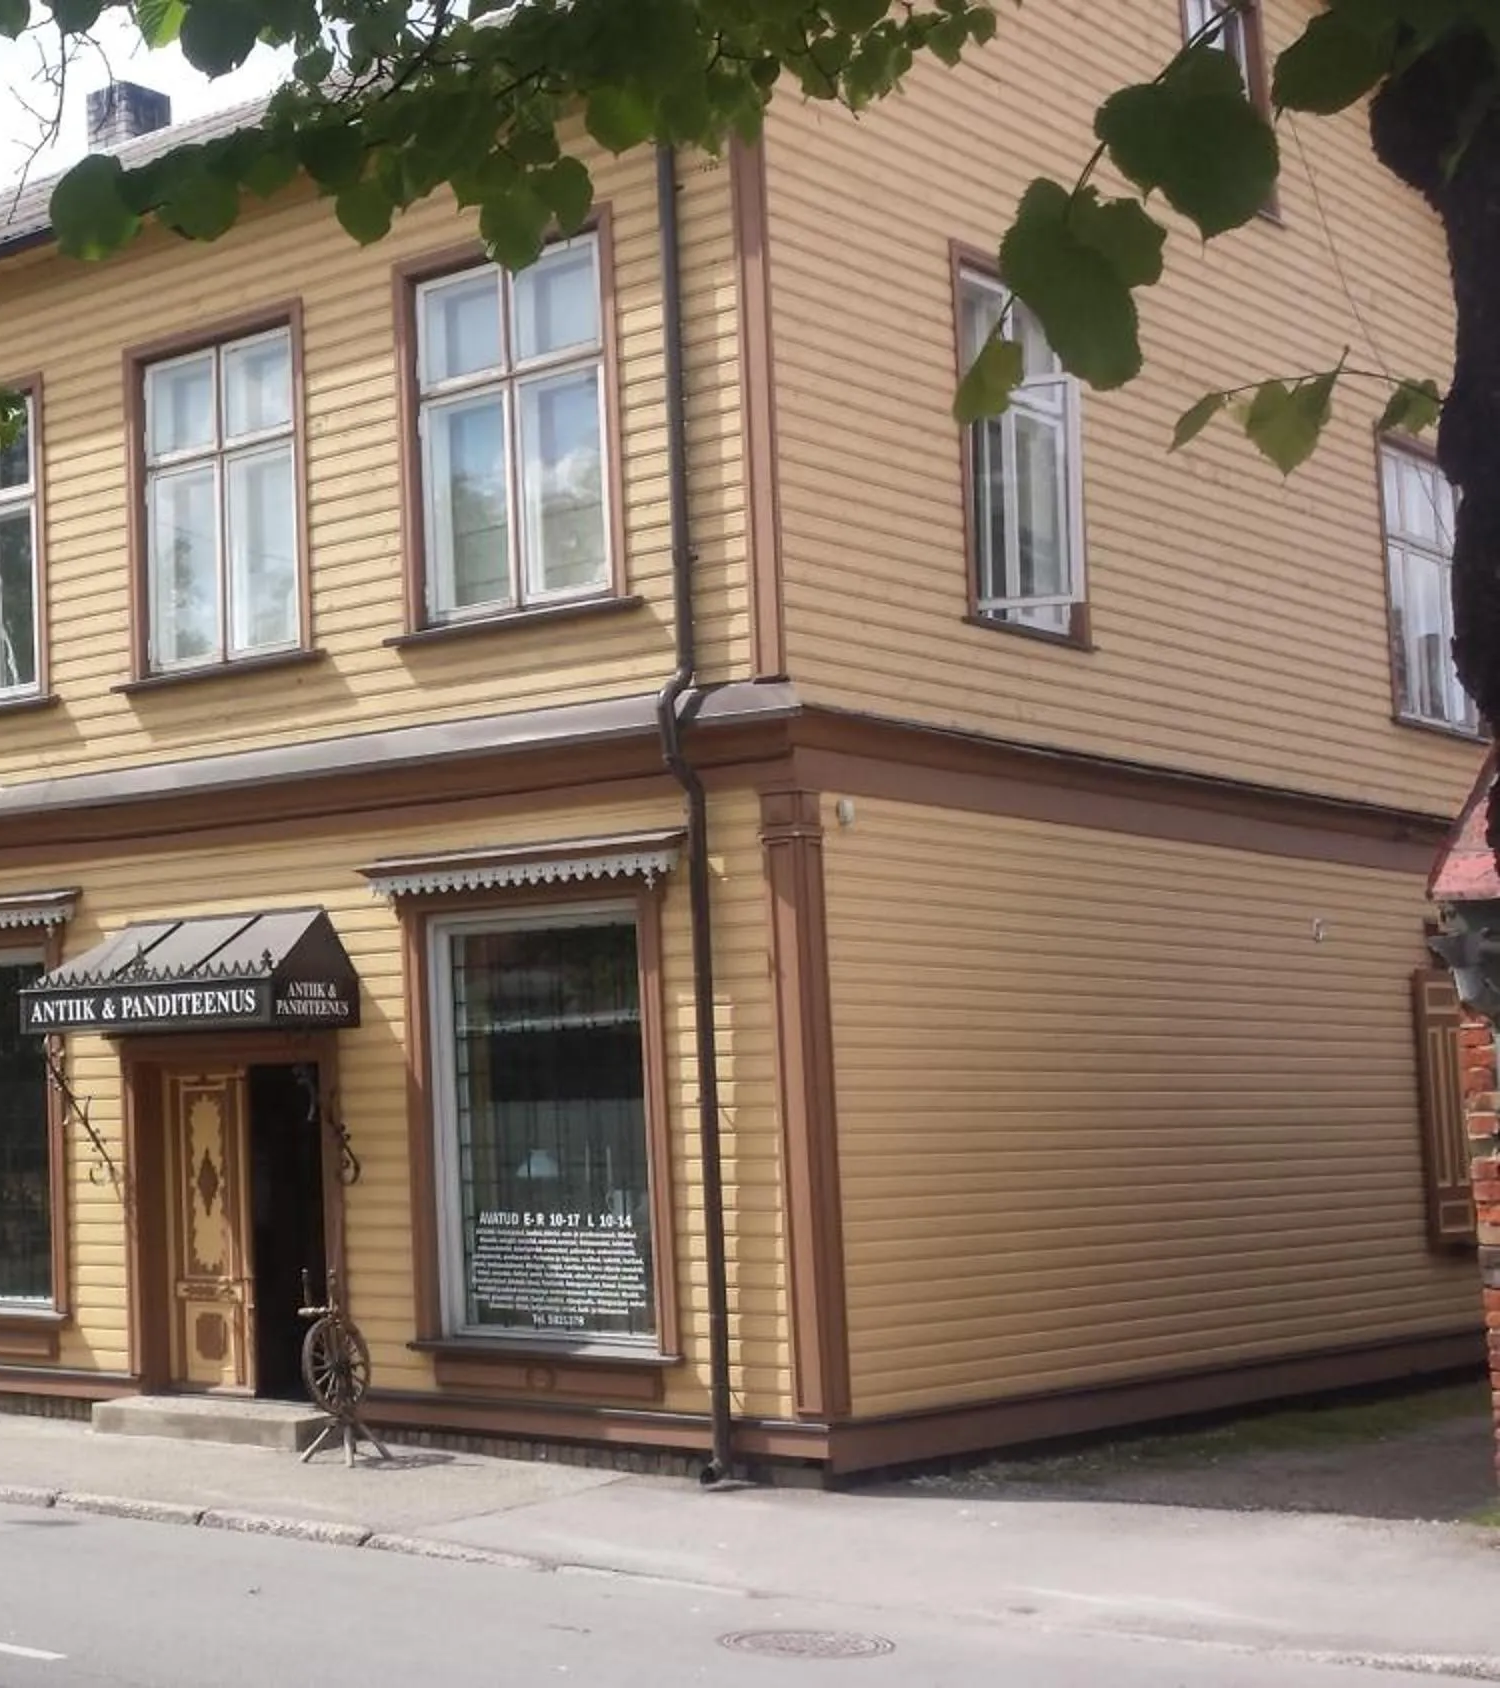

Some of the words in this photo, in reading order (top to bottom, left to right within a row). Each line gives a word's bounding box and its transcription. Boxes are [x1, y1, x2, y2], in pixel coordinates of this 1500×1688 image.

[287, 981, 326, 998] ANTIIK
[327, 982, 337, 999] &
[30, 997, 97, 1024] ANTIIK
[101, 997, 117, 1020] &
[120, 988, 257, 1020] PANDITEENUS
[275, 998, 350, 1017] PANDITEENUS
[479, 1211, 519, 1227] AVATUD
[550, 1213, 580, 1228] 10-17
[587, 1214, 595, 1228] L
[599, 1214, 633, 1229] 10-14
